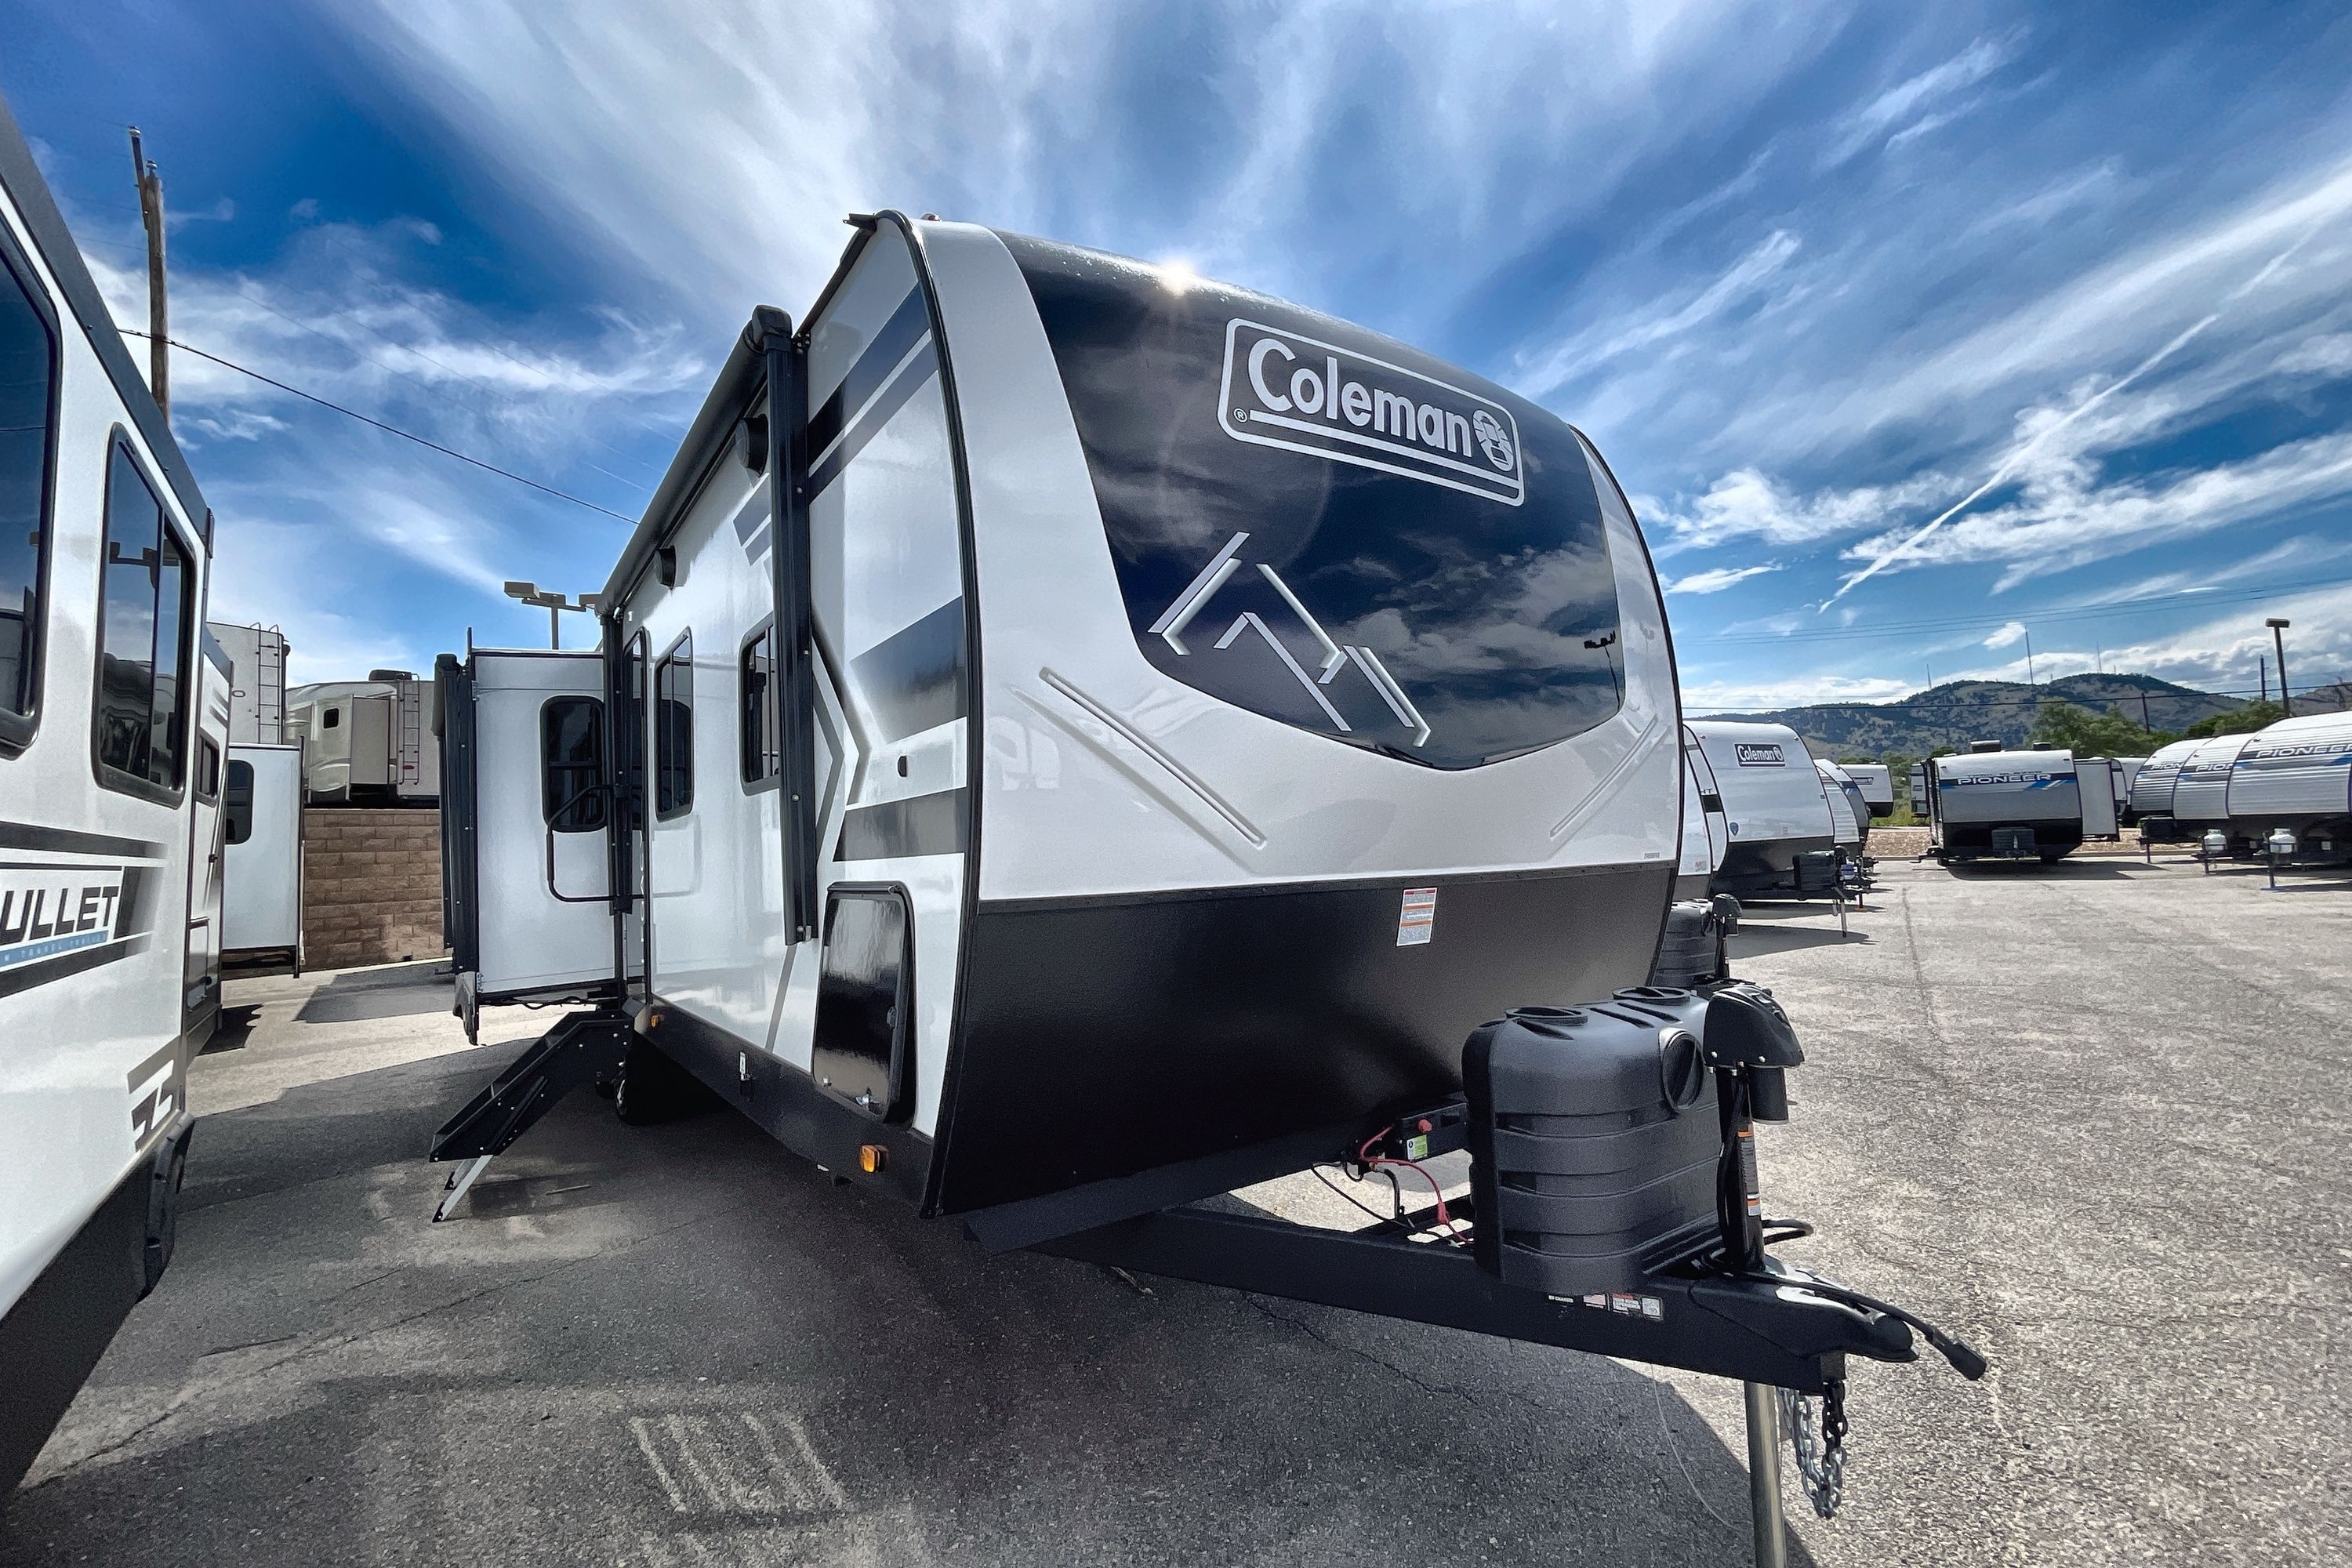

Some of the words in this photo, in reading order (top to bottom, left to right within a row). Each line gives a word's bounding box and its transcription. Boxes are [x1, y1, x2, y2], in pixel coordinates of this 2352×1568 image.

[1248, 338, 1472, 457] Coleman
[1737, 745, 1776, 761] Coleman
[1958, 773, 2051, 785] PIONEER
